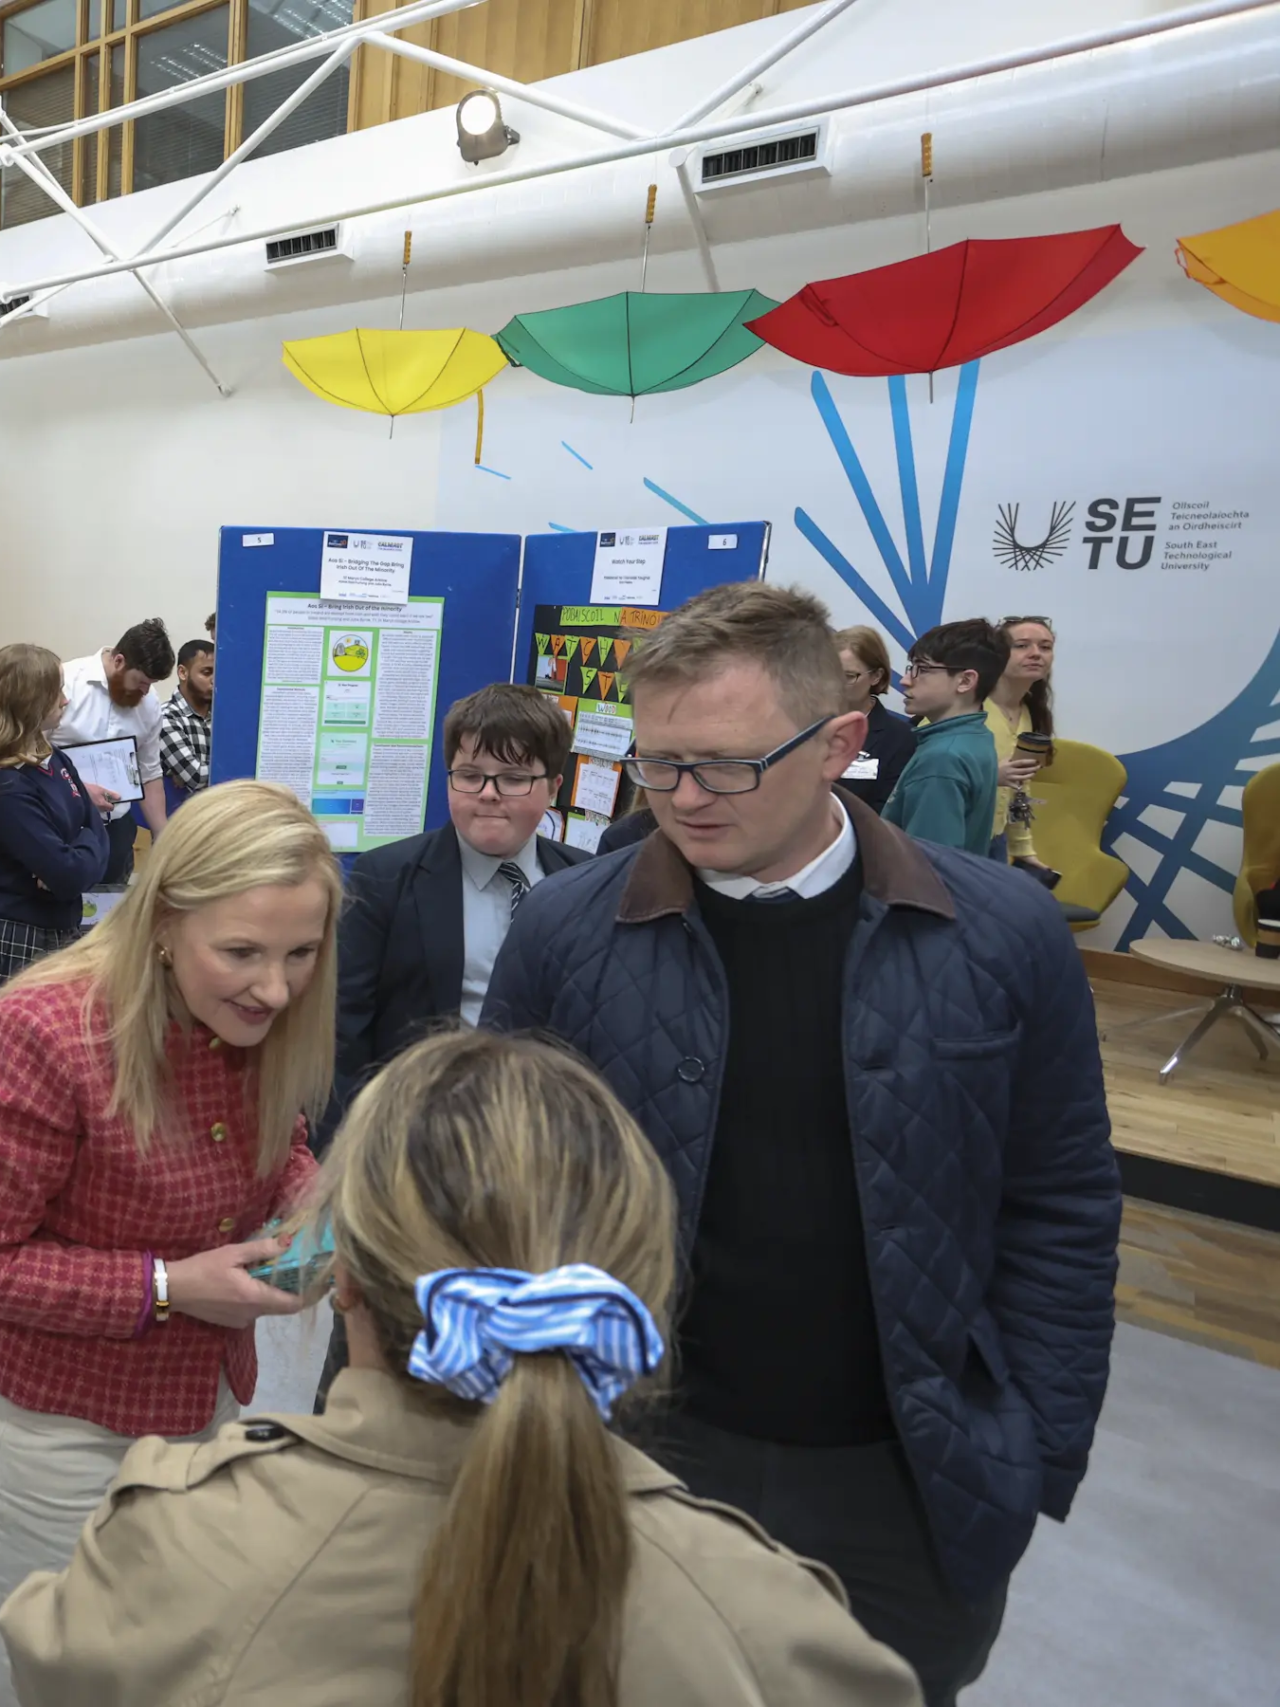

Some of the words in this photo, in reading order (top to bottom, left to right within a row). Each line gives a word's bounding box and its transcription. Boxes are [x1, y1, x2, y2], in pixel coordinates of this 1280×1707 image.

[1172, 501, 1210, 510] Ollscoil
[1085, 496, 1162, 533] SE
[1168, 523, 1181, 531] an
[1182, 520, 1242, 531] Oirdheiscirt
[722, 538, 727, 546] 6
[1165, 541, 1194, 549] South
[1196, 541, 1218, 549] East
[1082, 535, 1155, 570] TU
[1162, 551, 1233, 561] Technological
[1160, 561, 1210, 571] University
